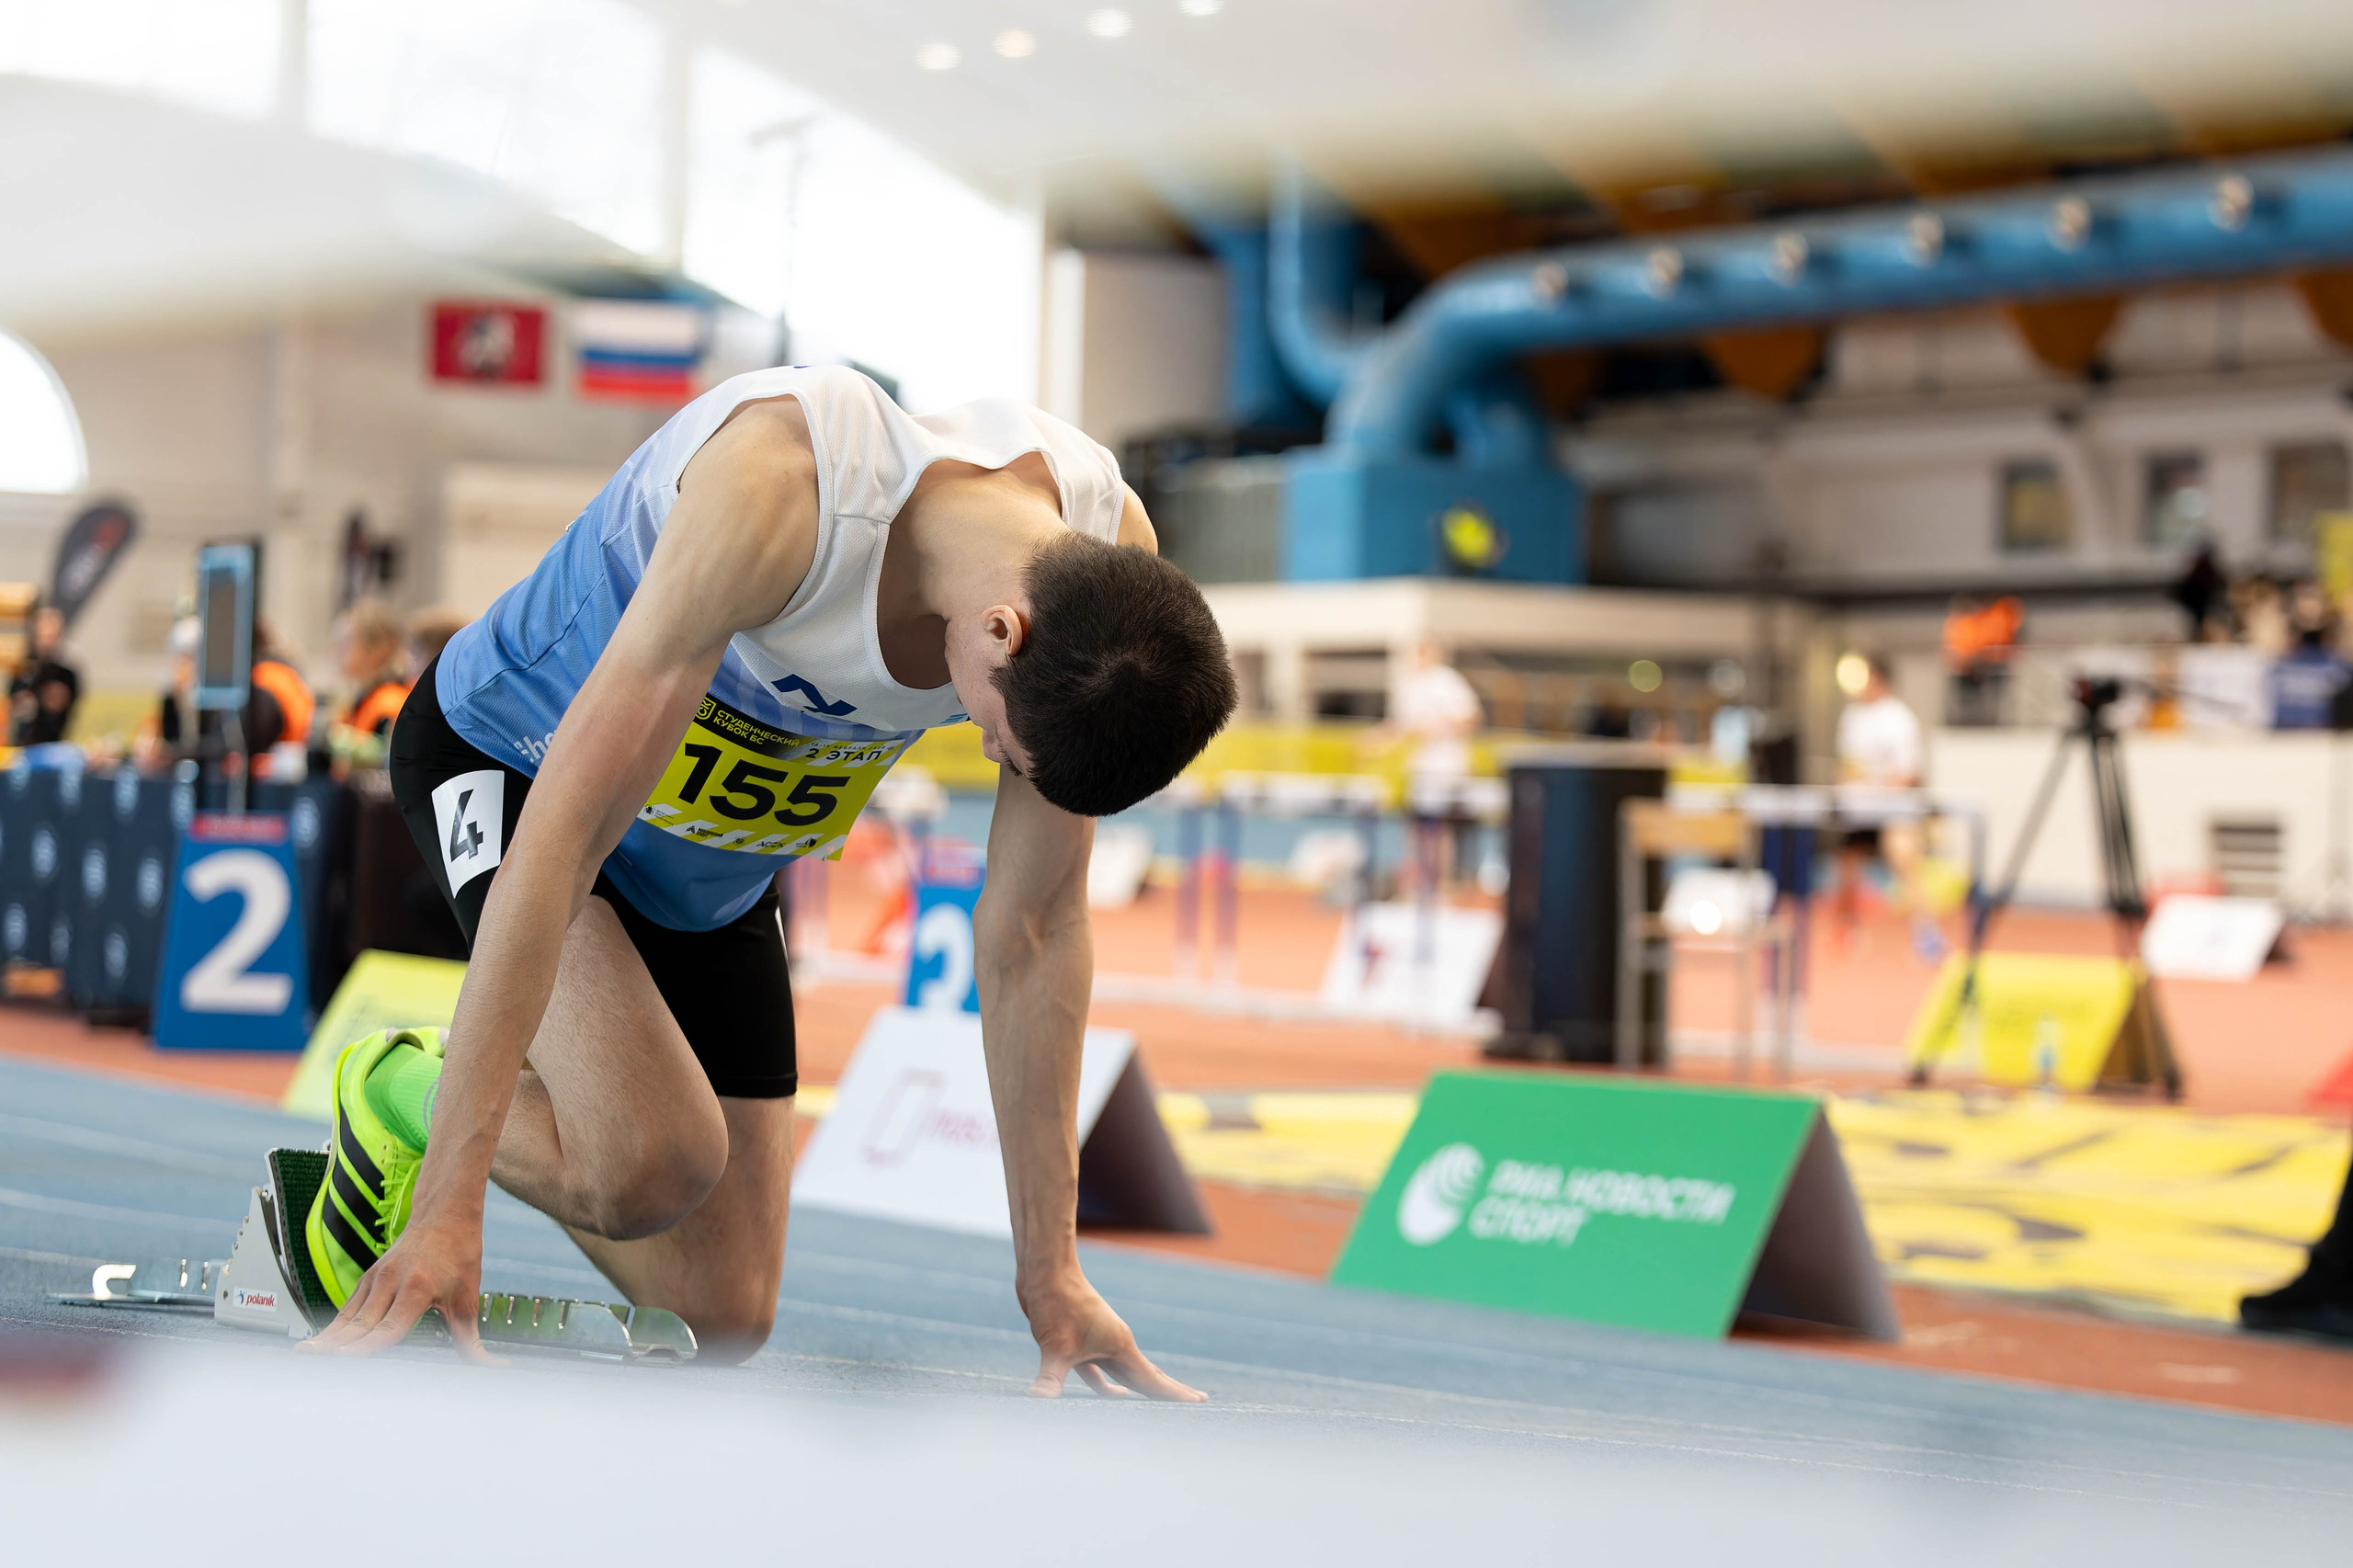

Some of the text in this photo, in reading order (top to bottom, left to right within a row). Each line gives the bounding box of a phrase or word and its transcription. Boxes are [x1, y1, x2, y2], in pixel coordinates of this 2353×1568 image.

[713, 716, 765, 745] КУБОК БС
[717, 710, 801, 747] СТУДЕНЧЕСКИЙ
[805, 748, 883, 762] 2 ЭТАП
[677, 743, 851, 826] 155
[449, 789, 484, 862] 4
[182, 849, 293, 1016] 2
[1563, 1166, 1736, 1226] НОВОСТИ
